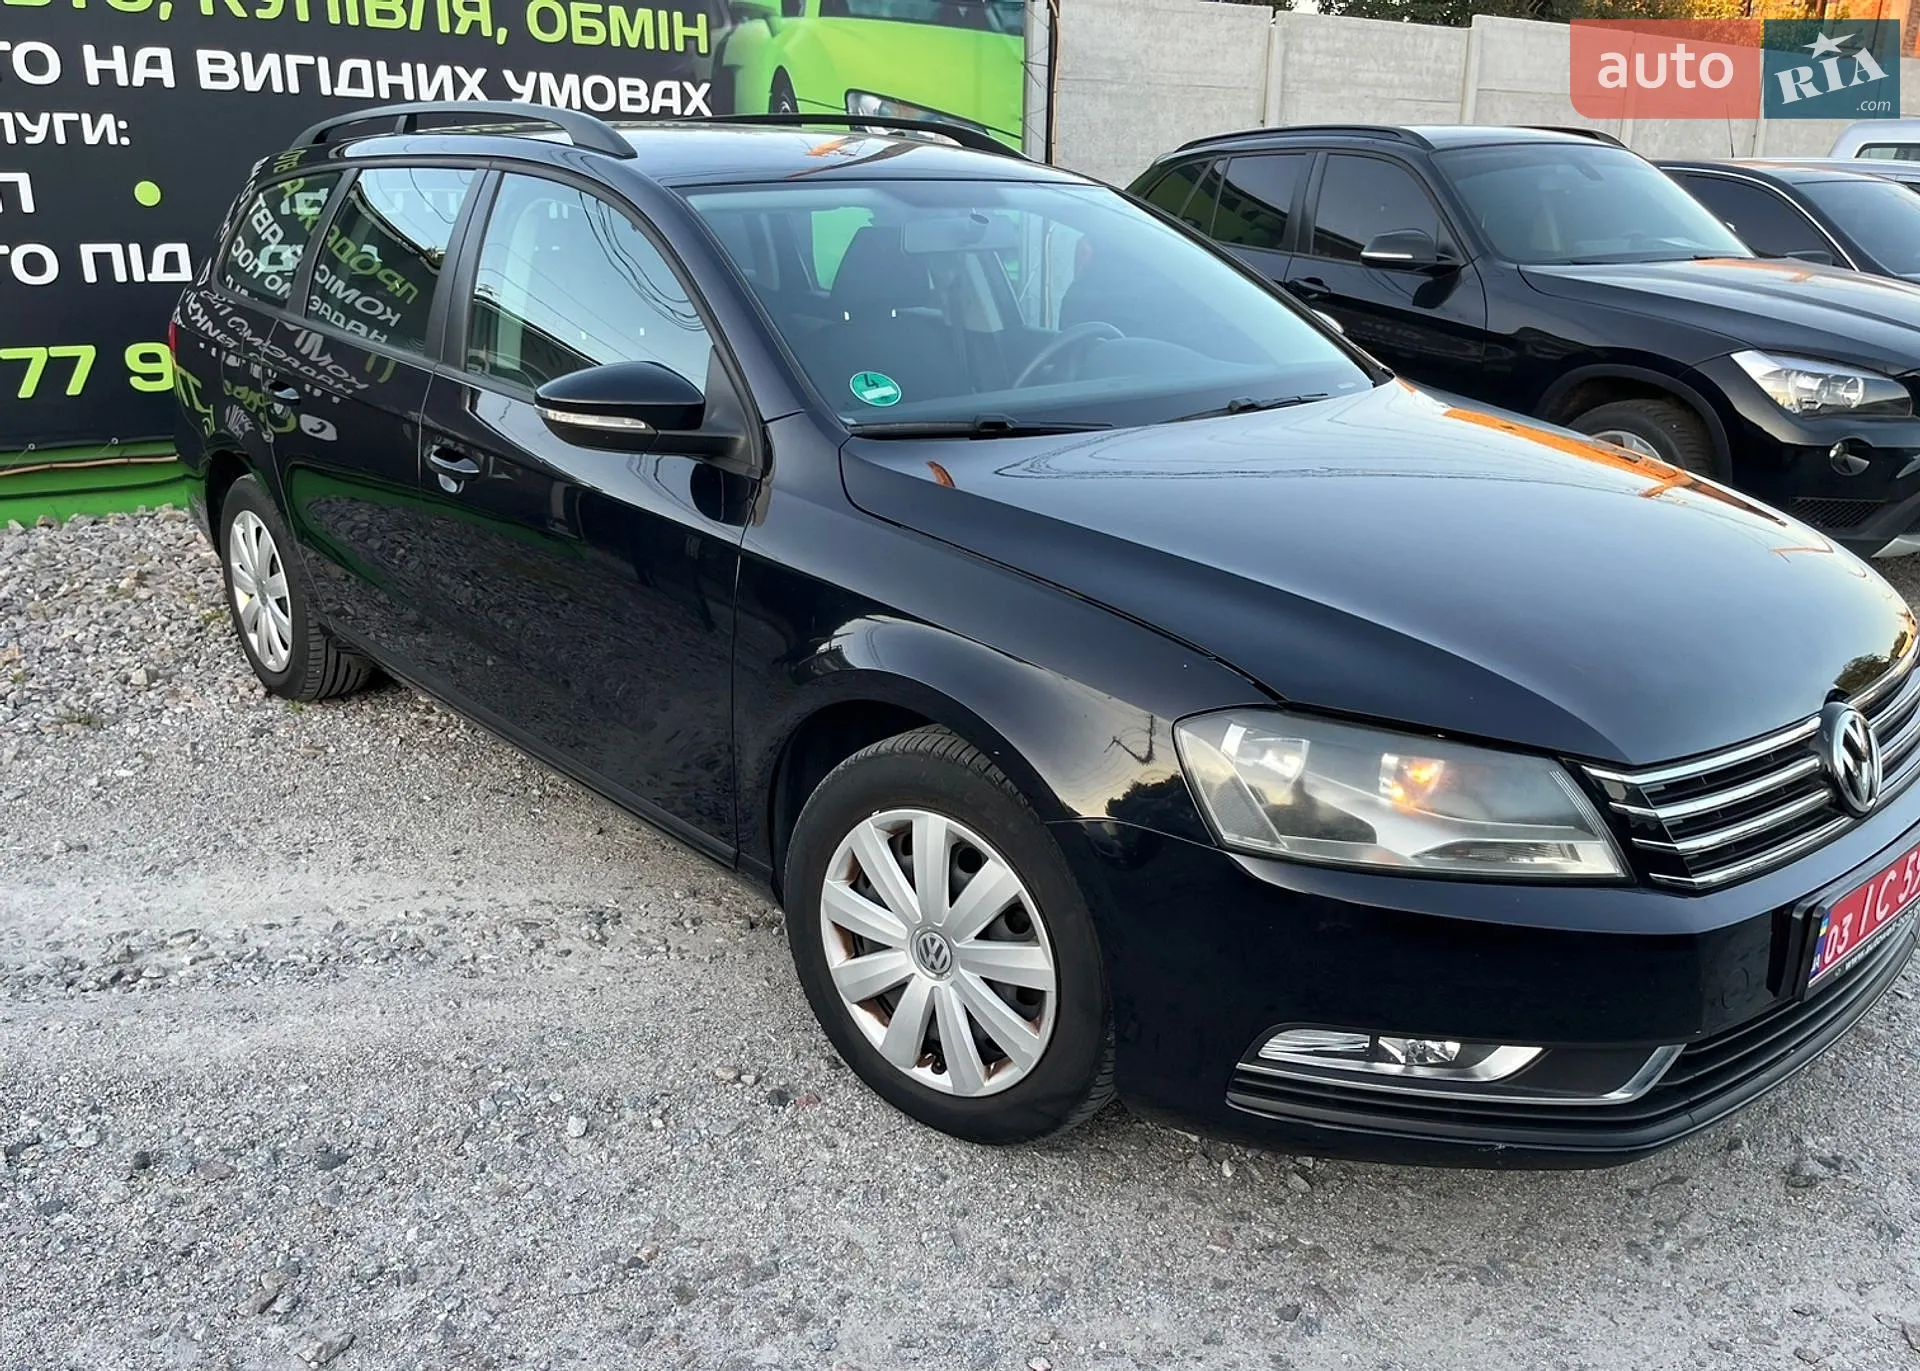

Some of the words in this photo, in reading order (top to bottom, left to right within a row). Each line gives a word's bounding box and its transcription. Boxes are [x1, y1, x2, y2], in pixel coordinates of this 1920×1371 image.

[526, 0, 709, 54] ОБМІН
[82, 44, 176, 88] НА
[196, 49, 489, 101] ВИГІДНИХ
[502, 69, 713, 117] УМОВАХ
[0, 243, 60, 285] О
[79, 243, 193, 283] ПІД
[1824, 912, 1854, 965] 03
